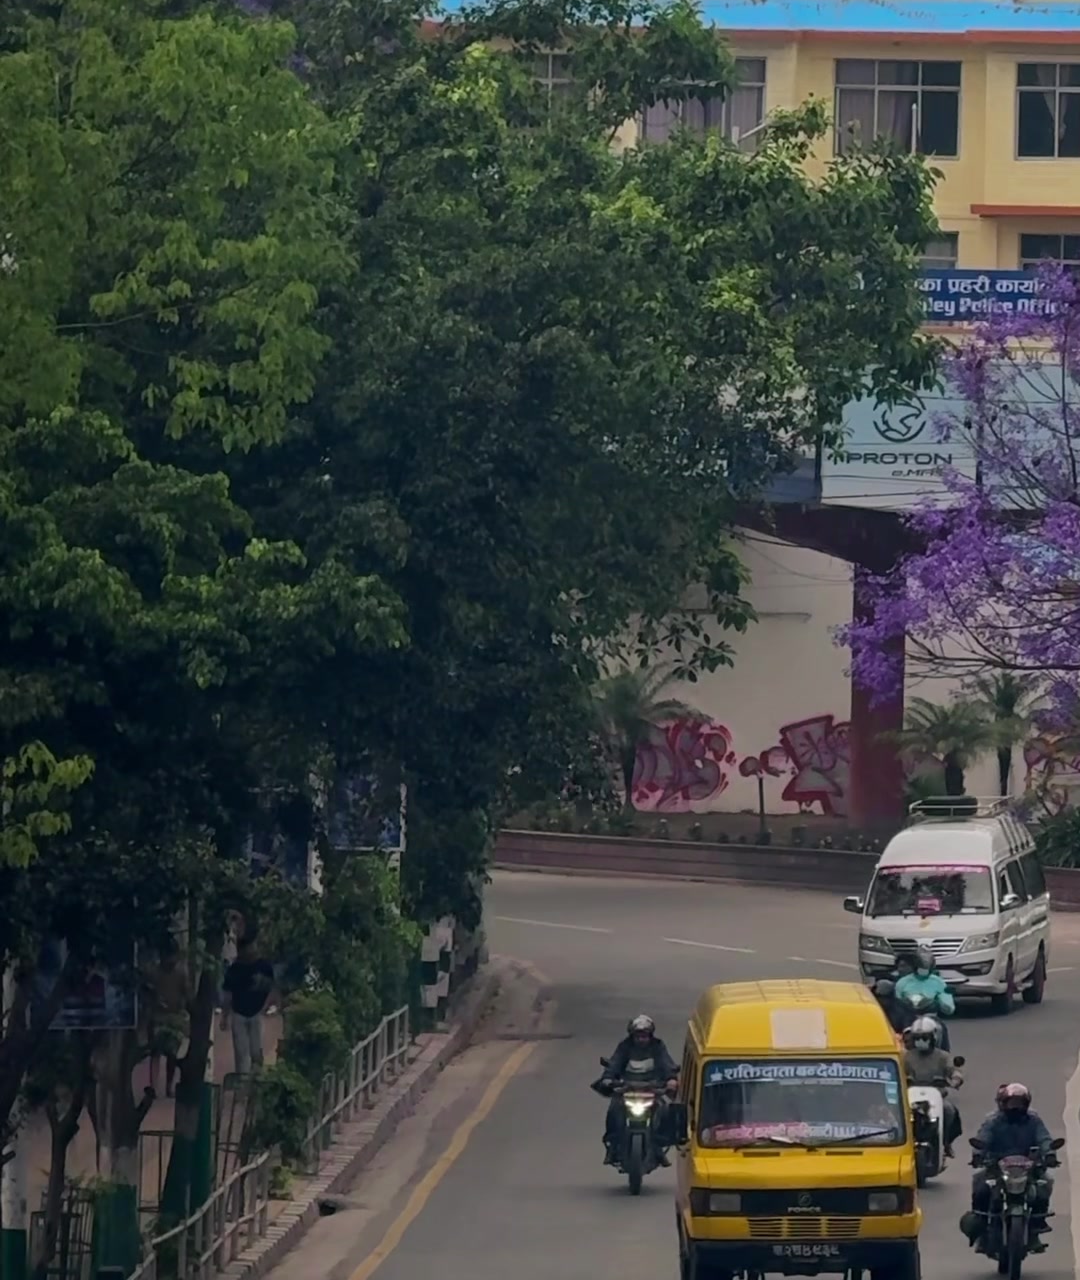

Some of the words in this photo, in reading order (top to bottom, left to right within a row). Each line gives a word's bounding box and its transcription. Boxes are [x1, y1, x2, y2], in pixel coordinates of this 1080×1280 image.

[947, 274, 991, 294] प्रहरी
[994, 276, 1045, 294] कार्या
[959, 296, 1013, 313] Police
[846, 452, 953, 465] PROTON
